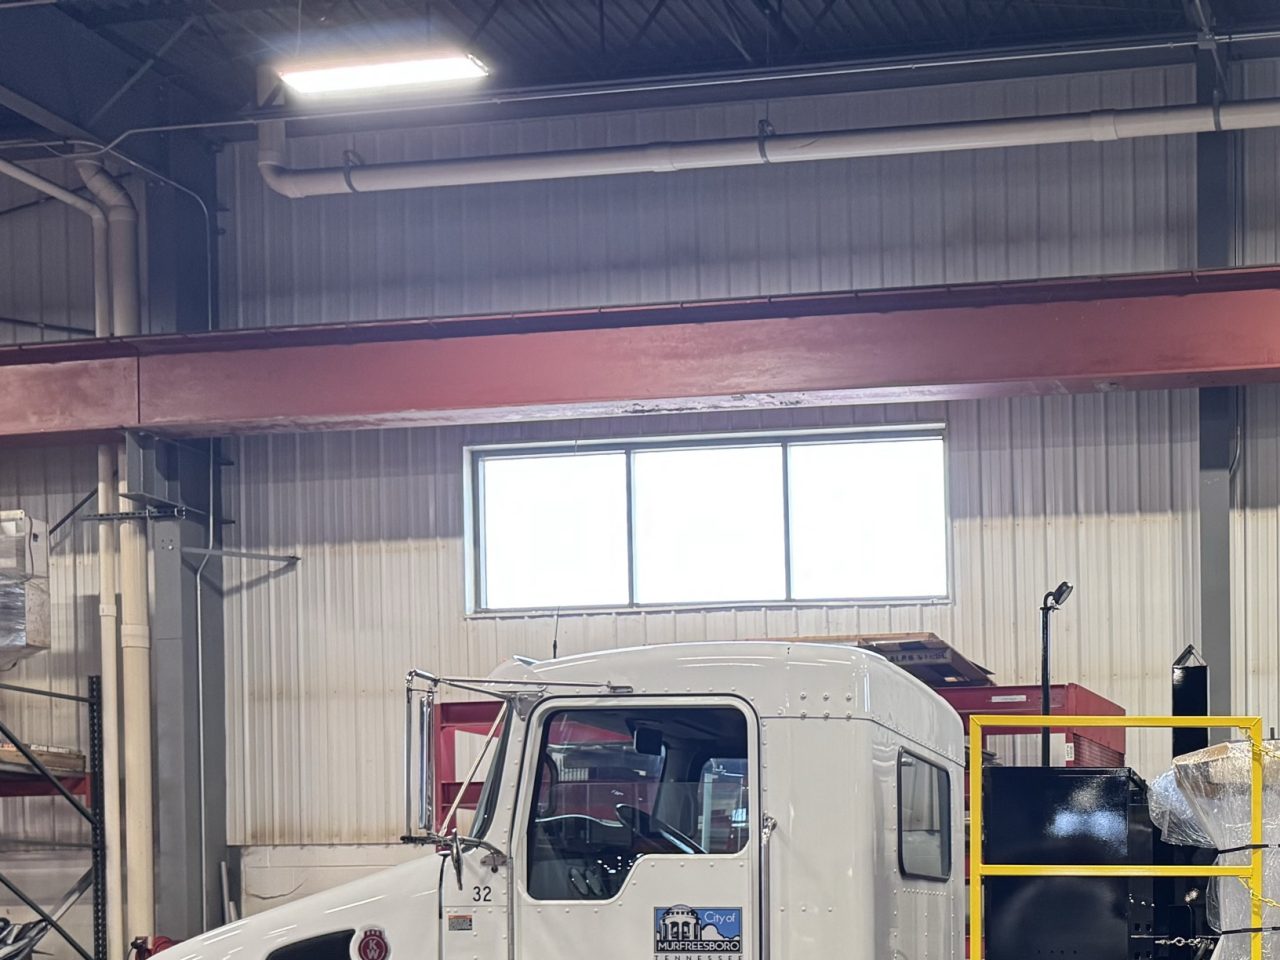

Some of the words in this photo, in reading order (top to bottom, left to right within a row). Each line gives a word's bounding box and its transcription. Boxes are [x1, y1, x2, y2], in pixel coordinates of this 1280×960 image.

[472, 886, 492, 902] 32
[704, 911, 725, 925] City
[725, 914, 736, 923] of
[369, 940, 377, 950] K
[658, 942, 740, 951] MURFREESBORO
[367, 950, 379, 960] W
